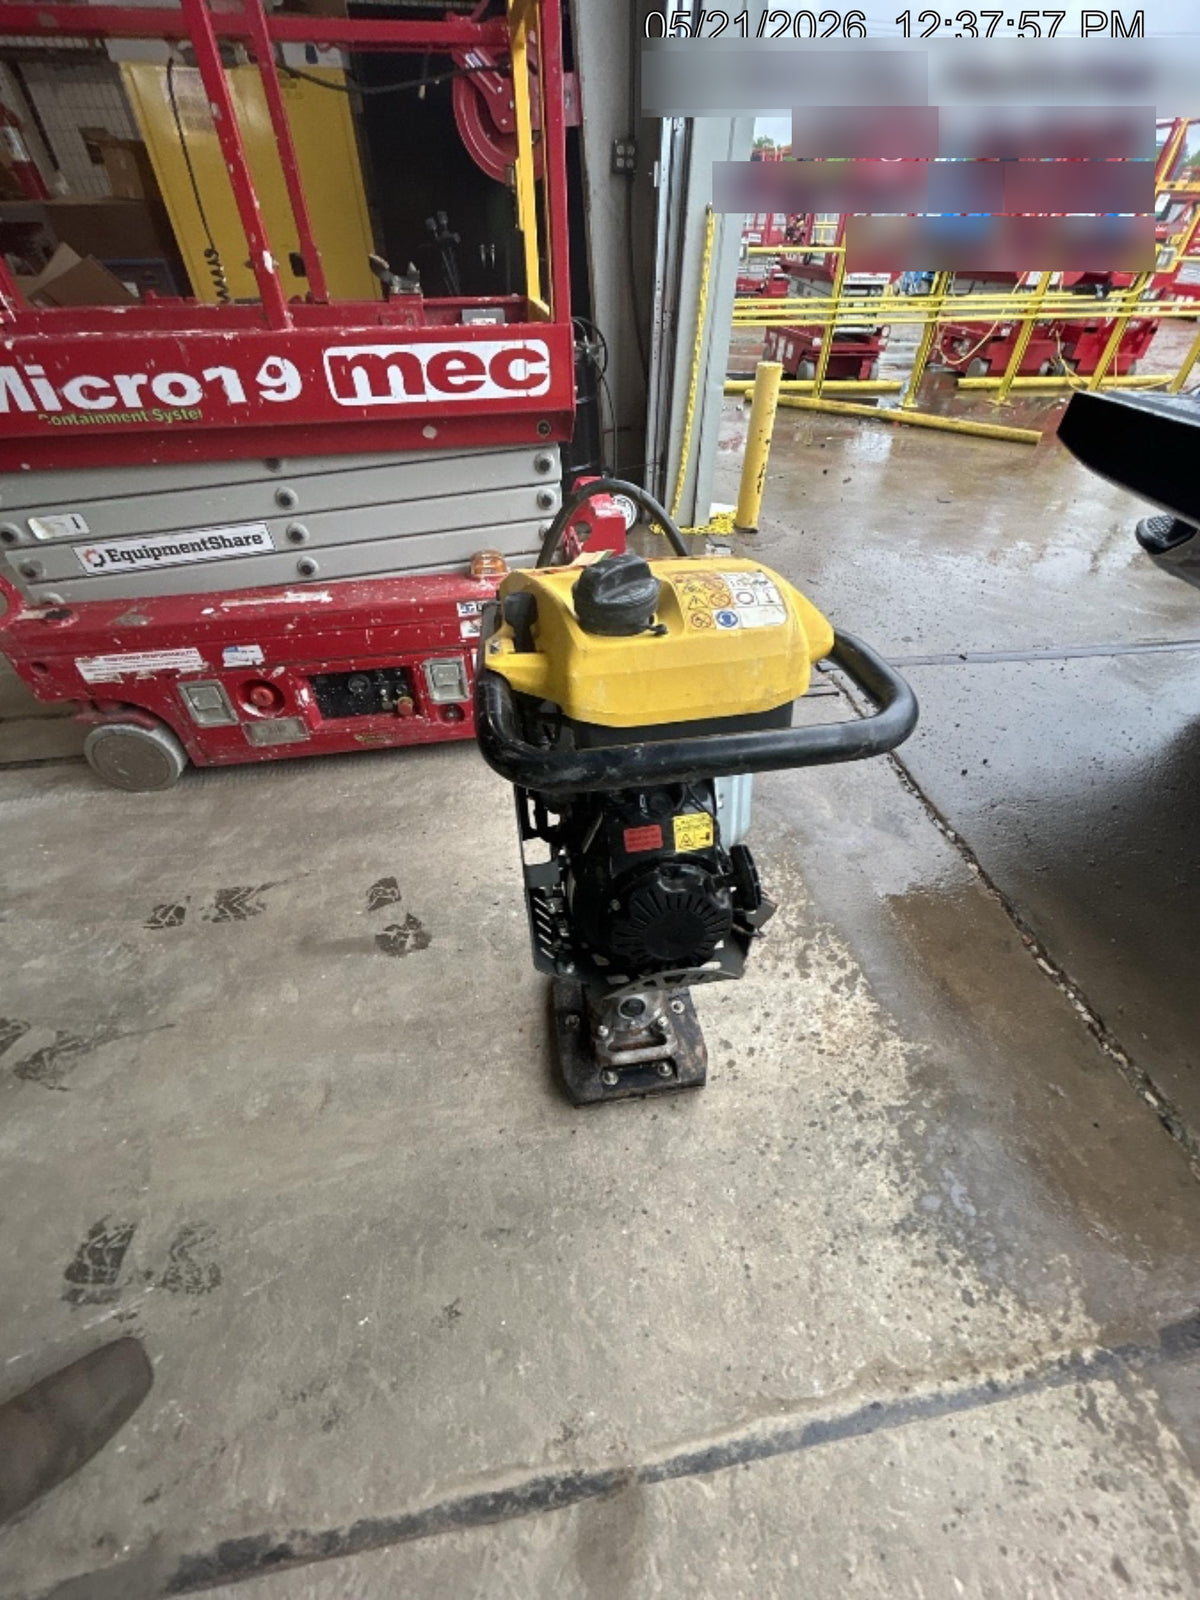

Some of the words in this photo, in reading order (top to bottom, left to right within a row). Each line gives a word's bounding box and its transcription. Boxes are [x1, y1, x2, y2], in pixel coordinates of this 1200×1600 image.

[327, 348, 548, 399] mec
[152, 408, 202, 424] Syste
[105, 533, 263, 564] EquipmentShare
